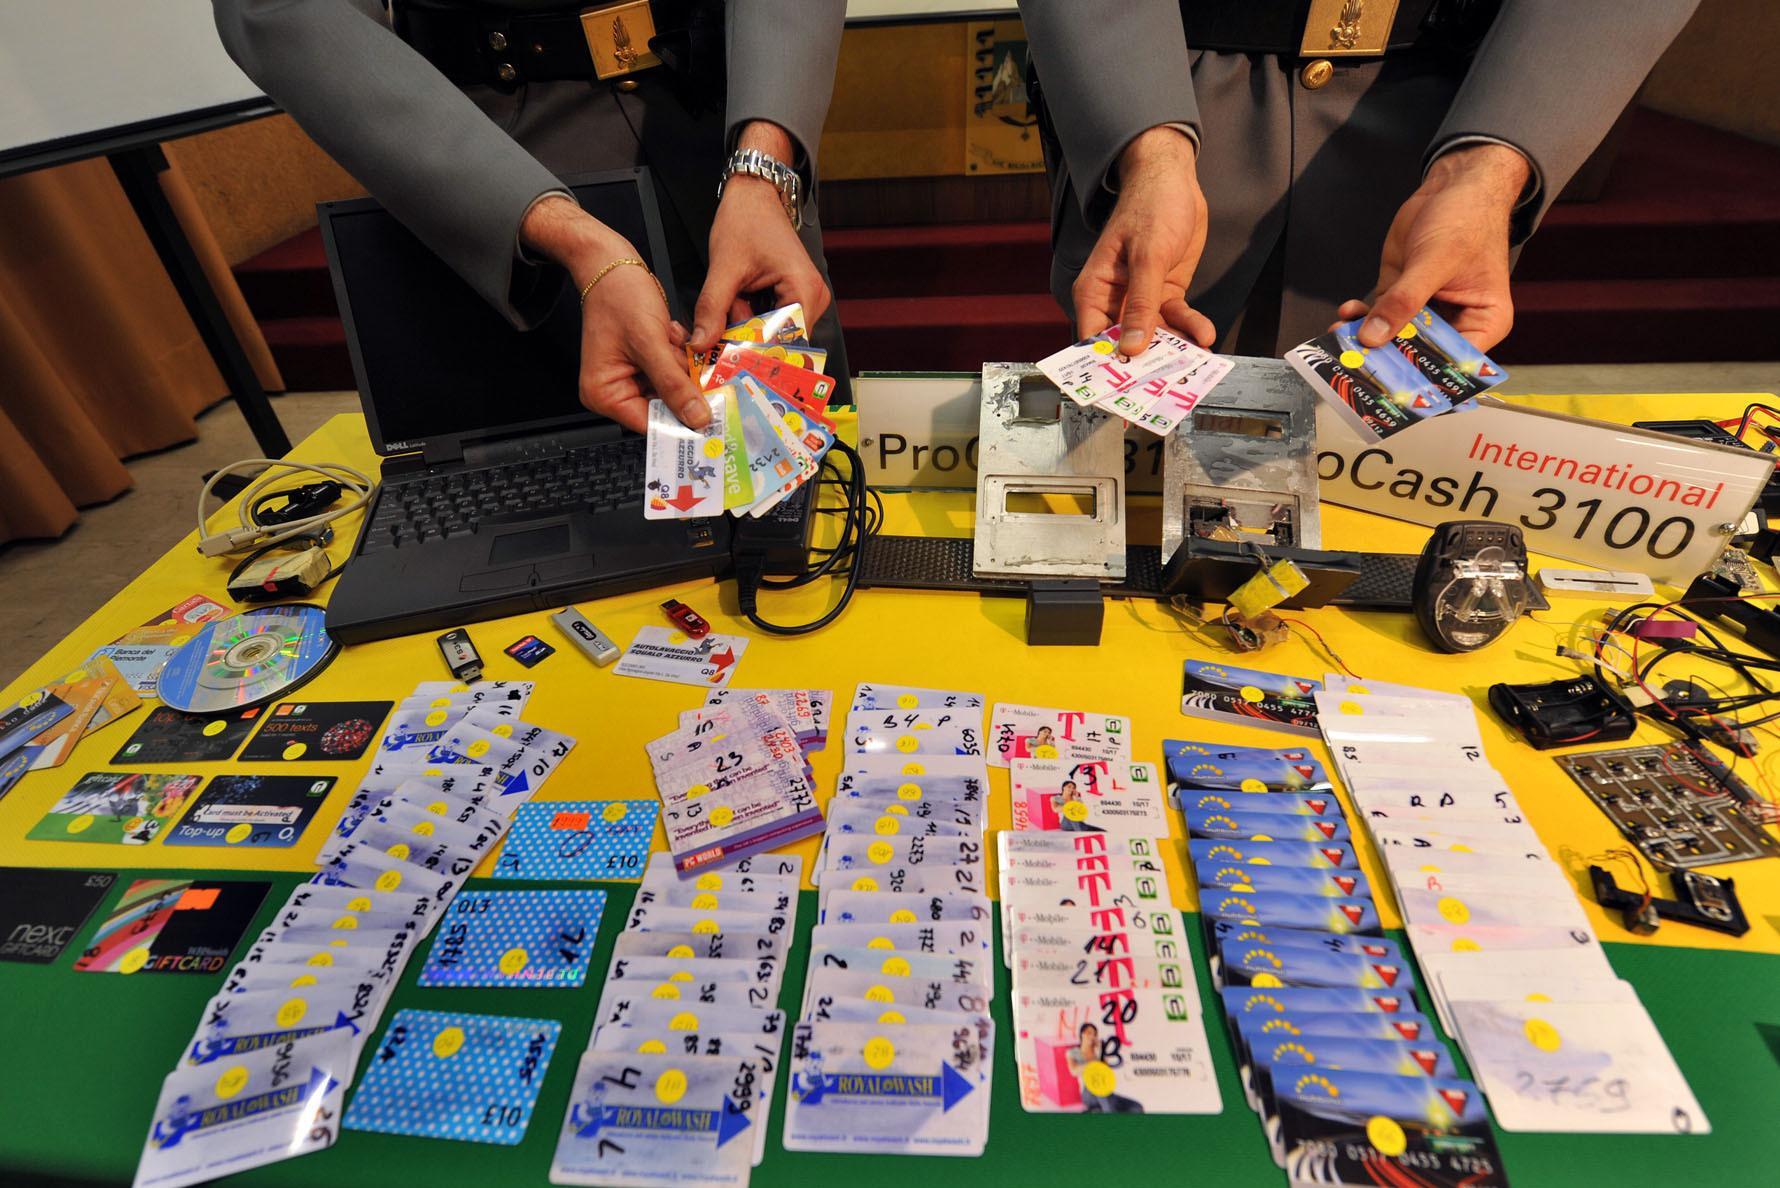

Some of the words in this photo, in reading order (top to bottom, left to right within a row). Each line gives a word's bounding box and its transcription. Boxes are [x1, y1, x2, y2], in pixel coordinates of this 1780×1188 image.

[386, 442, 409, 452] DELL
[1468, 433, 1724, 509] International
[661, 484, 670, 499] Q8
[1520, 487, 1695, 560] 3100
[141, 648, 156, 656] del
[633, 643, 695, 656] AUTOLAVAGGIO
[663, 652, 703, 664] AZZURRO
[701, 668, 716, 677] Q8
[794, 690, 811, 719] 2269
[1256, 702, 1284, 713] 0455
[263, 723, 289, 733] 500
[289, 722, 319, 733] texts
[903, 713, 921, 727] 4
[1057, 712, 1085, 741] T
[961, 729, 981, 756] 6035
[714, 751, 744, 773] 23
[789, 778, 812, 814] 2772
[221, 808, 239, 817] must
[253, 808, 294, 818] Activated
[178, 825, 225, 838] Top-up
[605, 855, 640, 869] £10
[684, 855, 697, 868] PC
[697, 847, 723, 863] WORLD
[84, 876, 112, 888] £50
[1078, 872, 1112, 907] T
[8, 923, 75, 944] next
[146, 955, 227, 971] GIFTCARD
[1101, 999, 1139, 1026] 20
[481, 1103, 523, 1128] £10
